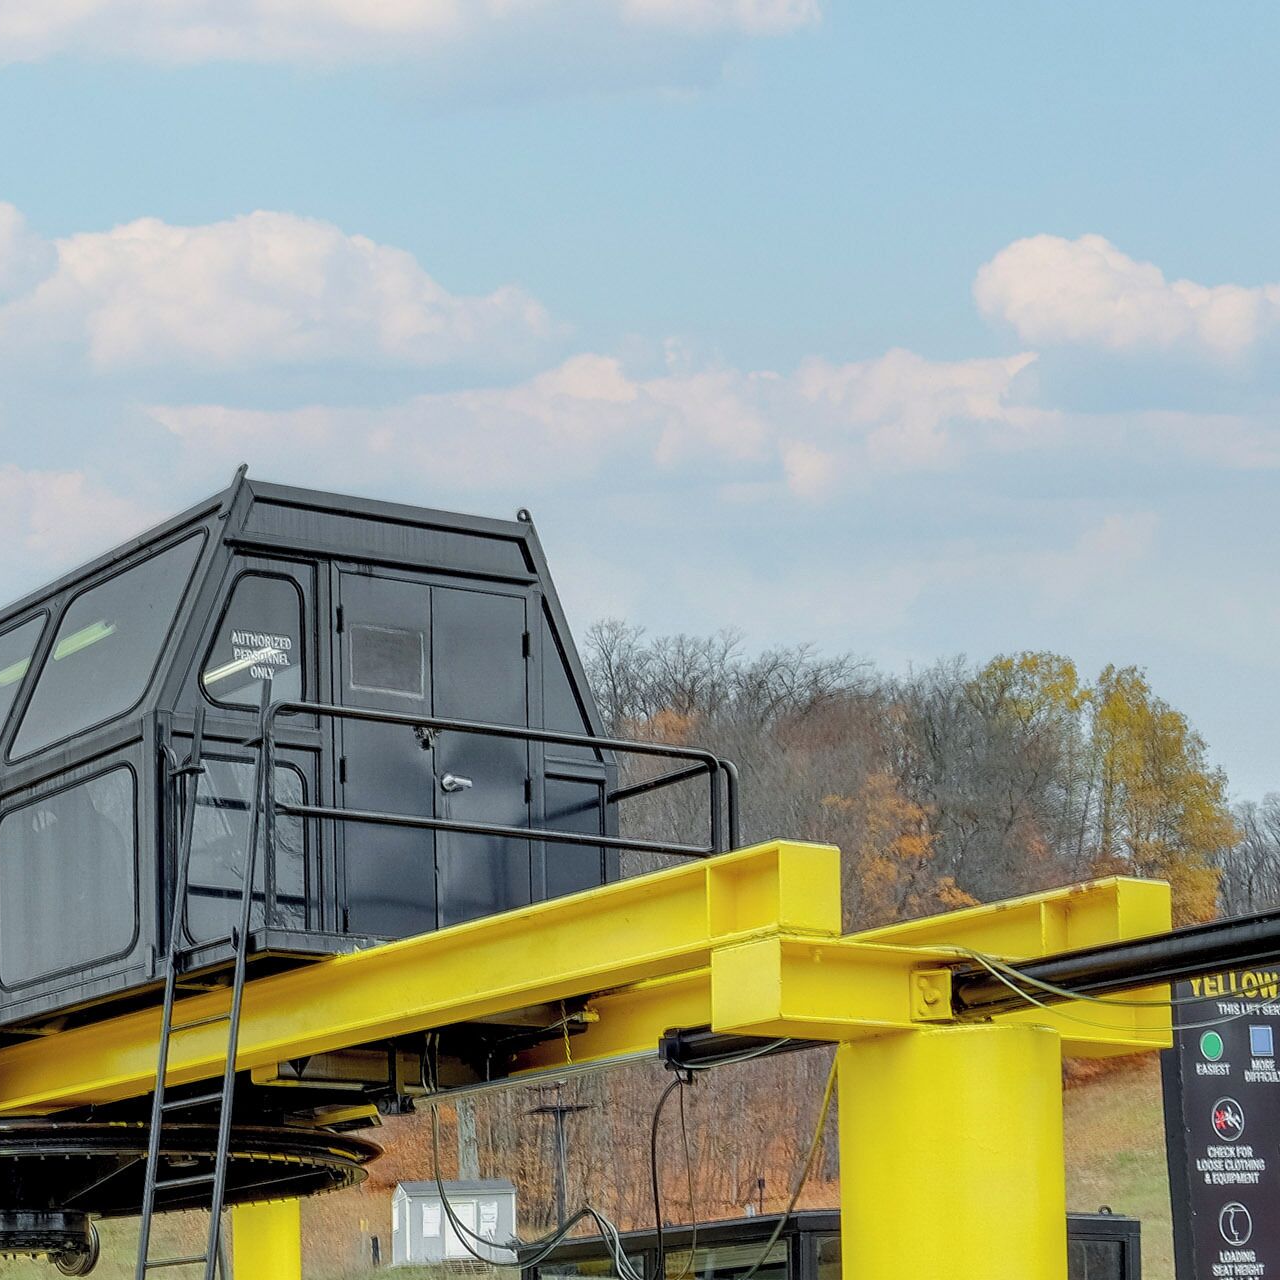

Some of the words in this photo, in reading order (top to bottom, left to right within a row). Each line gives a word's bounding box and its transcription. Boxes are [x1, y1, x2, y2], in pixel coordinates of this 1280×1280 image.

[231, 630, 291, 650] AUTHORIZED
[233, 646, 291, 666] PERSONNEL
[250, 664, 275, 680] ONLY
[1190, 970, 1278, 998] YELLOW
[1216, 1002, 1240, 1015] THIS
[1196, 1063, 1231, 1075] EASIEST
[1251, 1058, 1276, 1071] MORE
[1207, 1145, 1235, 1158] CHECK
[1236, 1146, 1253, 1158] FOR
[1196, 1158, 1224, 1171] LOOSE
[1224, 1158, 1265, 1171] CLOTHING
[1204, 1172, 1212, 1184] &
[1212, 1172, 1260, 1185] EQUIPMENT
[1219, 1251, 1256, 1263] LOADING
[1212, 1264, 1234, 1276] SEAT
[1234, 1264, 1265, 1276] HEIGHT
